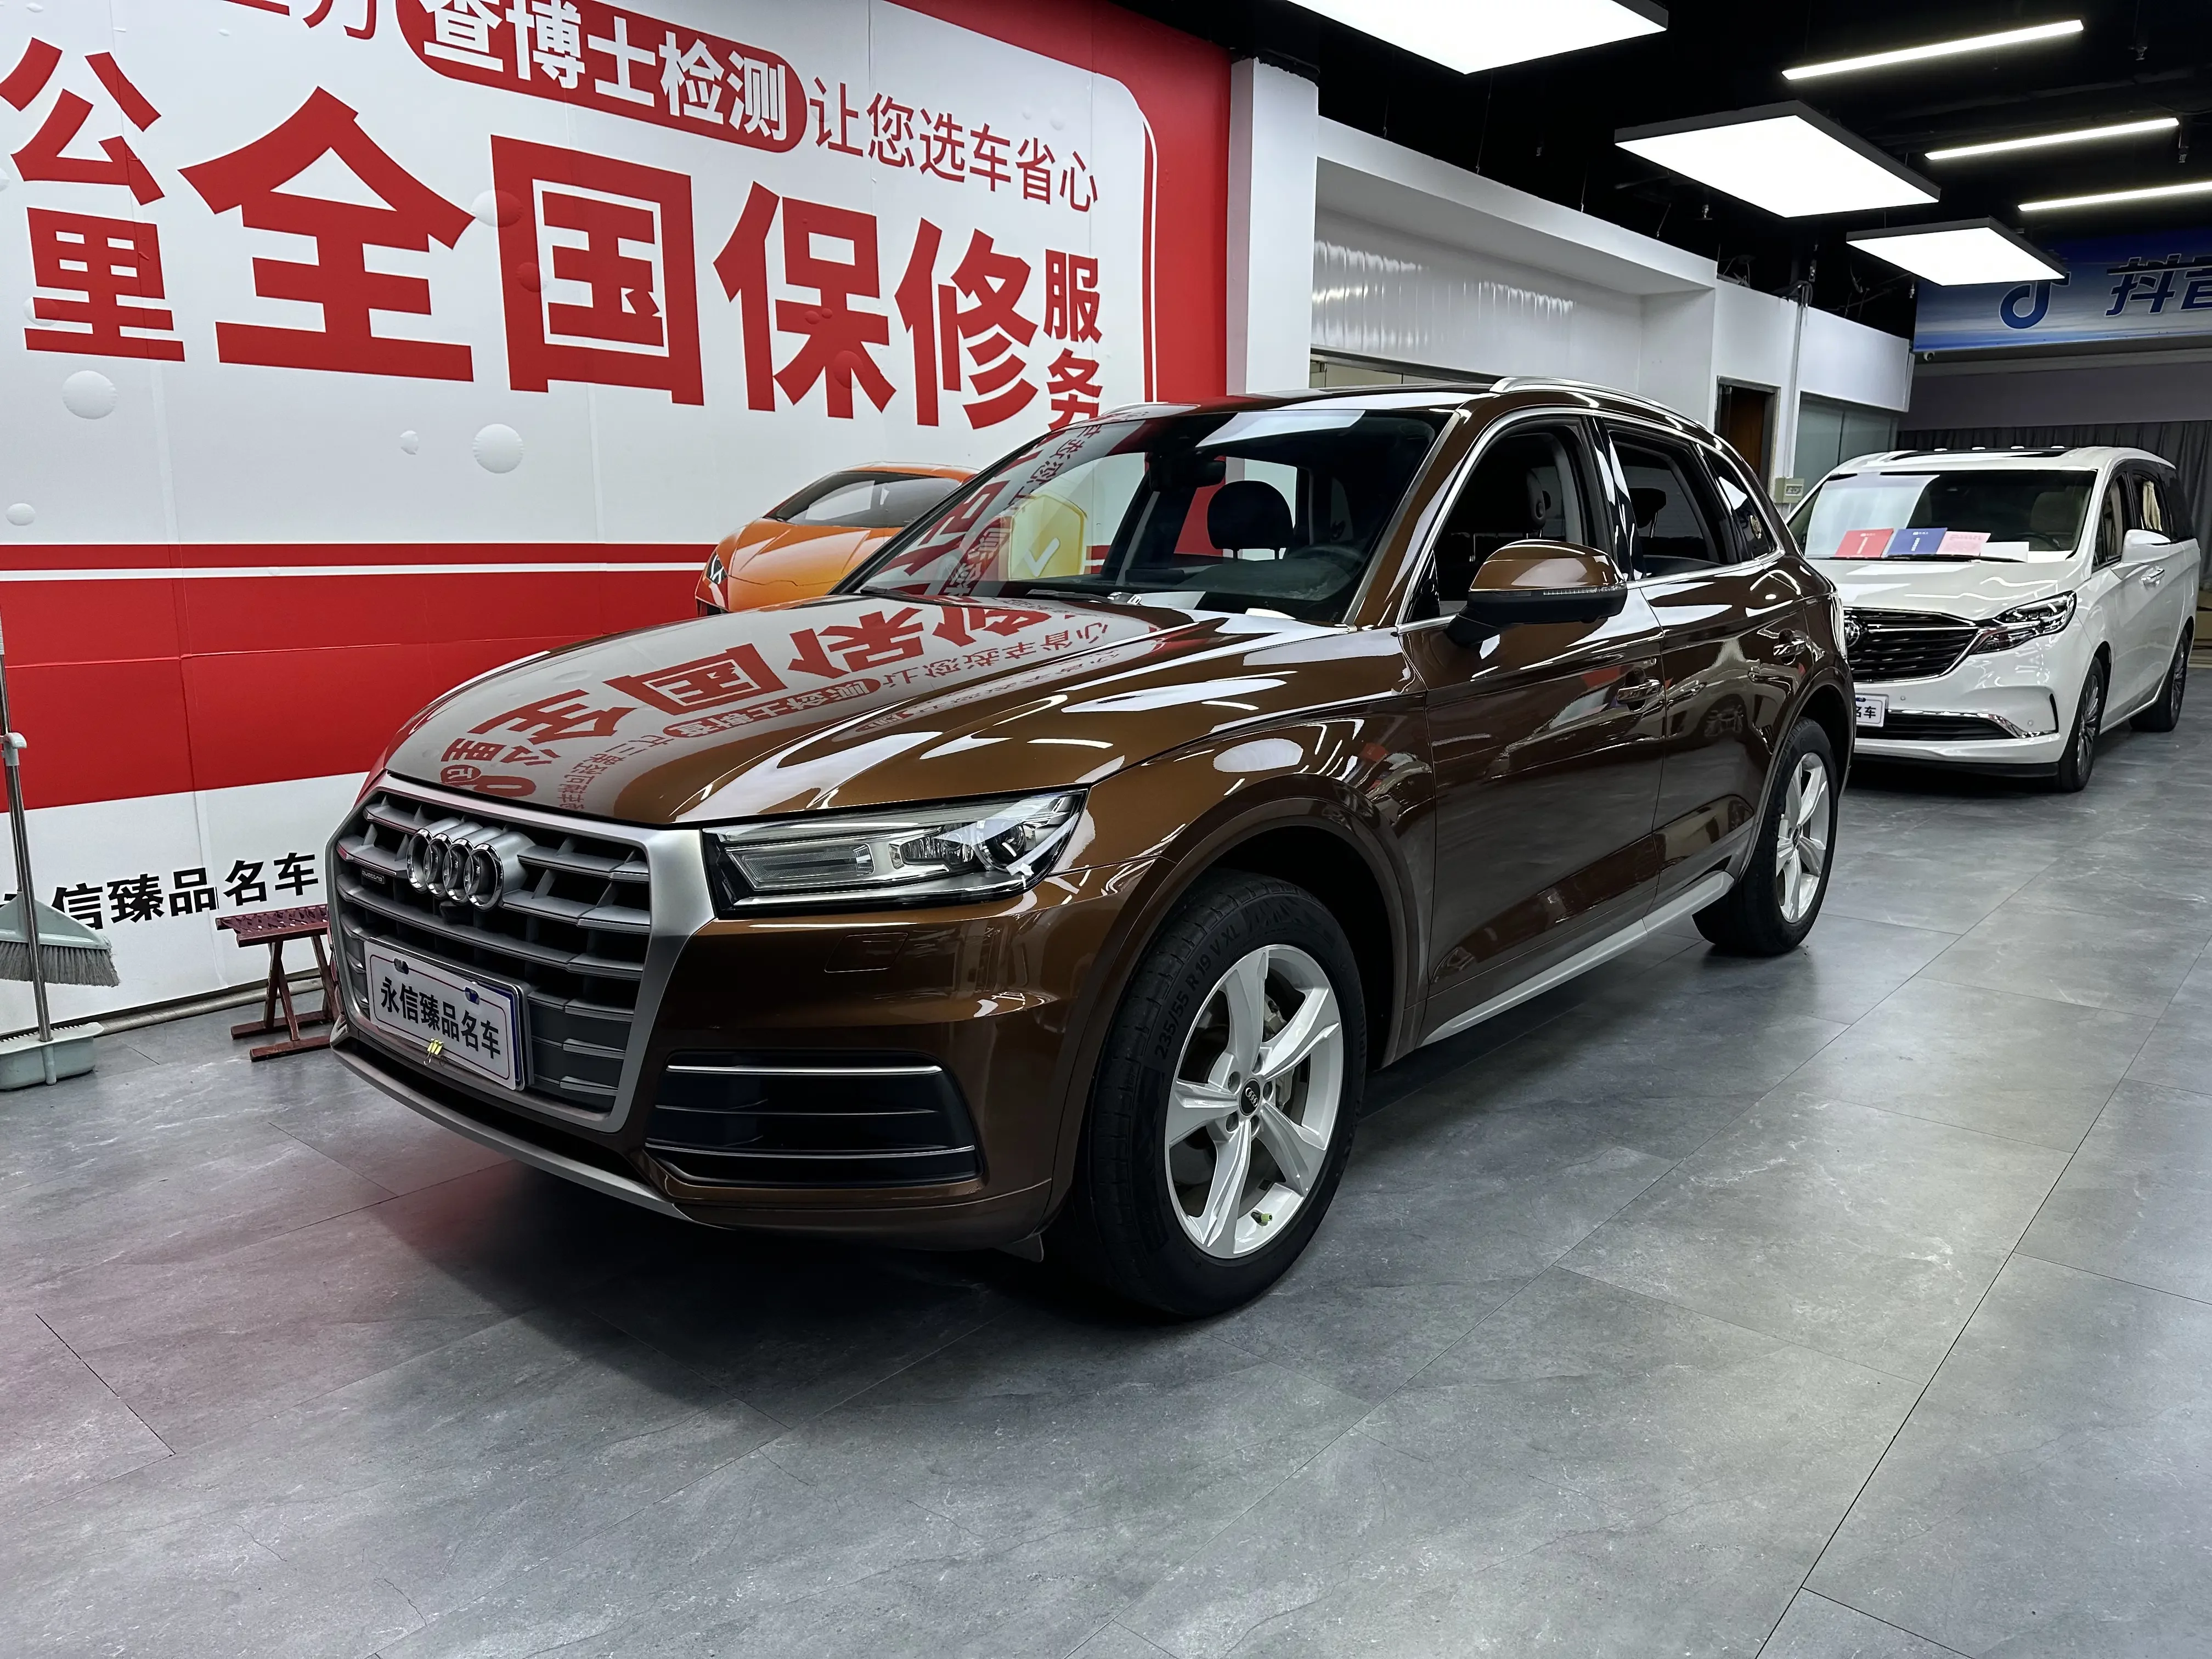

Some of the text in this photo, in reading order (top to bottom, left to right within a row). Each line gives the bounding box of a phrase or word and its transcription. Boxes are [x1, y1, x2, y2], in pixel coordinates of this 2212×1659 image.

[424, 0, 1098, 213] 查博士检测 让您选车省心
[0, 36, 1103, 431] 公里 全国保修 服务
[0, 852, 319, 930] 信臻品名车
[380, 976, 501, 1059] 永信臻品名车
[1154, 990, 1189, 1060] 235/55
[1186, 974, 1199, 991] R
[1195, 953, 1211, 977] 19
[1221, 924, 1240, 947] XL
